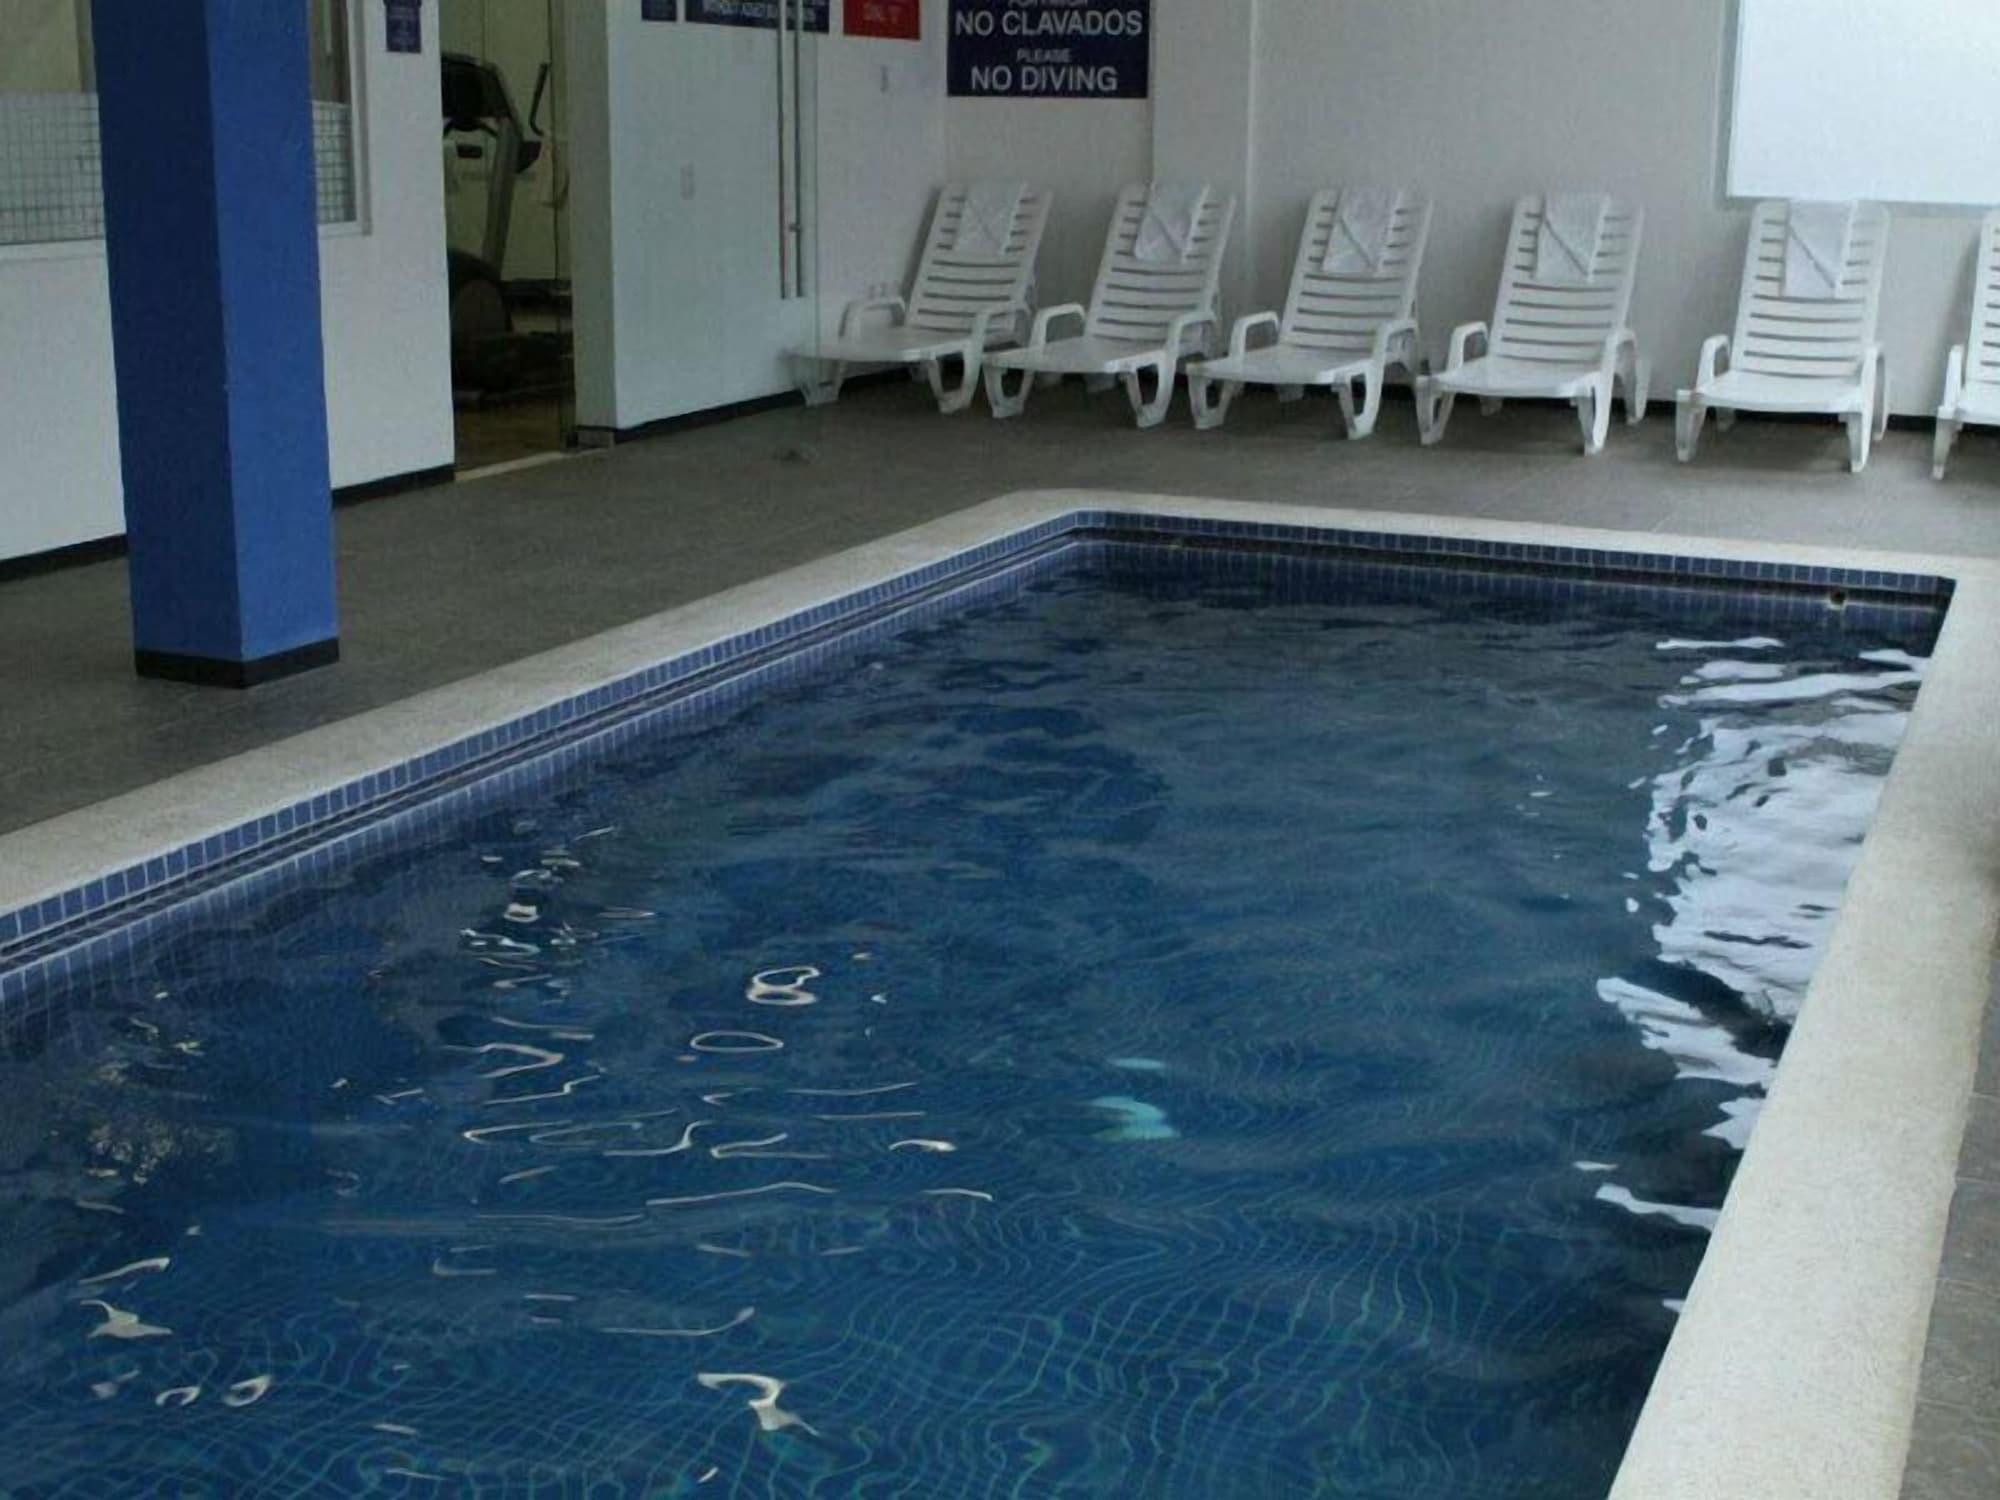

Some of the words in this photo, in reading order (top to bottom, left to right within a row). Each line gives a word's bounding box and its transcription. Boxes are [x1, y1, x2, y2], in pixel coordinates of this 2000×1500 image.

[955, 10, 994, 36] NO
[1001, 10, 1143, 36] CLAVADOS
[1016, 48, 1072, 63] PLEASE
[971, 66, 1013, 90] NO
[1021, 66, 1118, 91] DIVING
